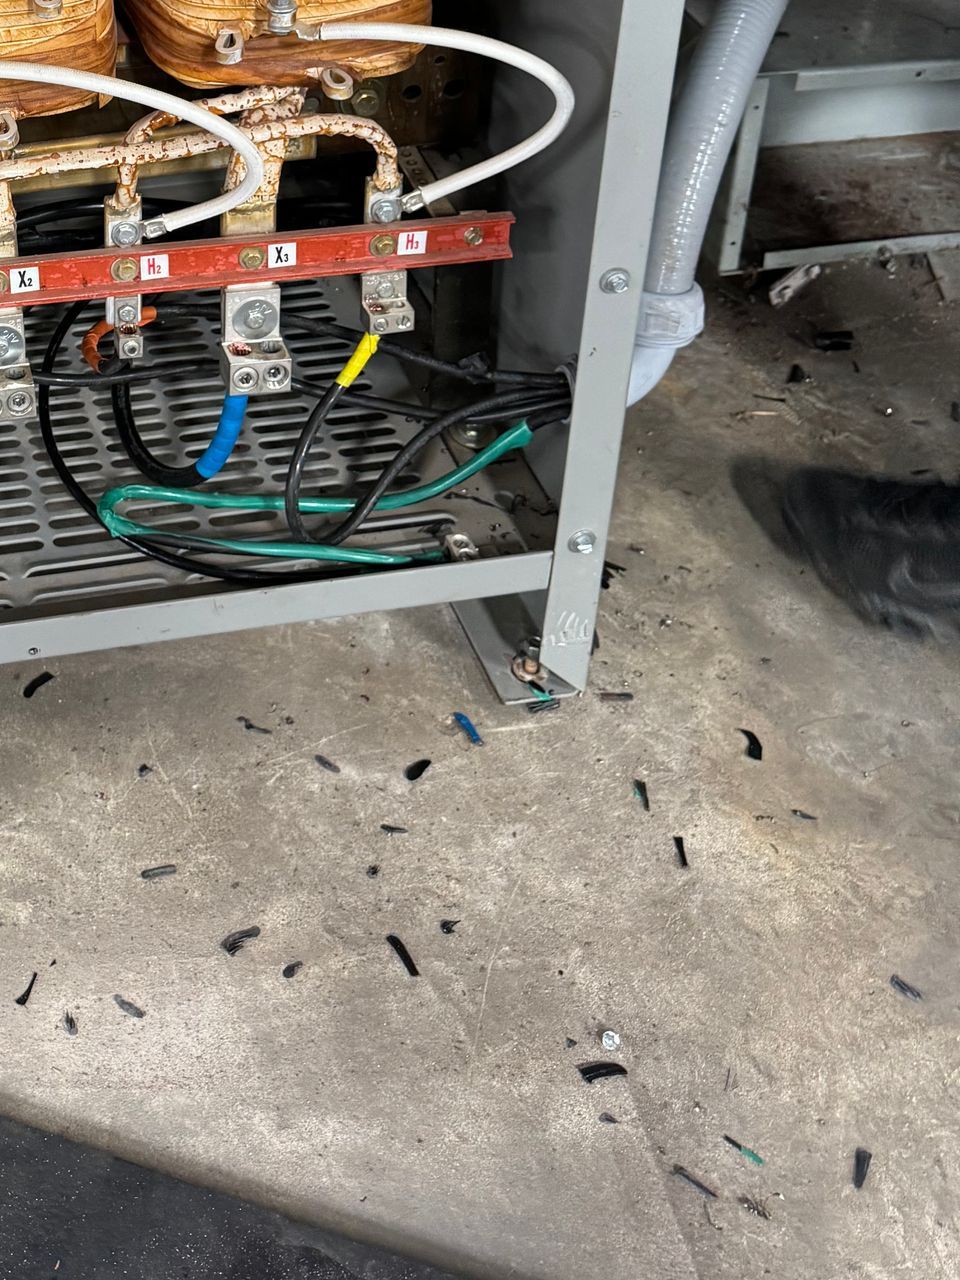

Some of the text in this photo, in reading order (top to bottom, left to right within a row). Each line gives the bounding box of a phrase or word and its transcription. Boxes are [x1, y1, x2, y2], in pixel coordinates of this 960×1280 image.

[275, 246, 289, 264] X3
[147, 257, 162, 275] H2
[18, 270, 33, 288] X2
